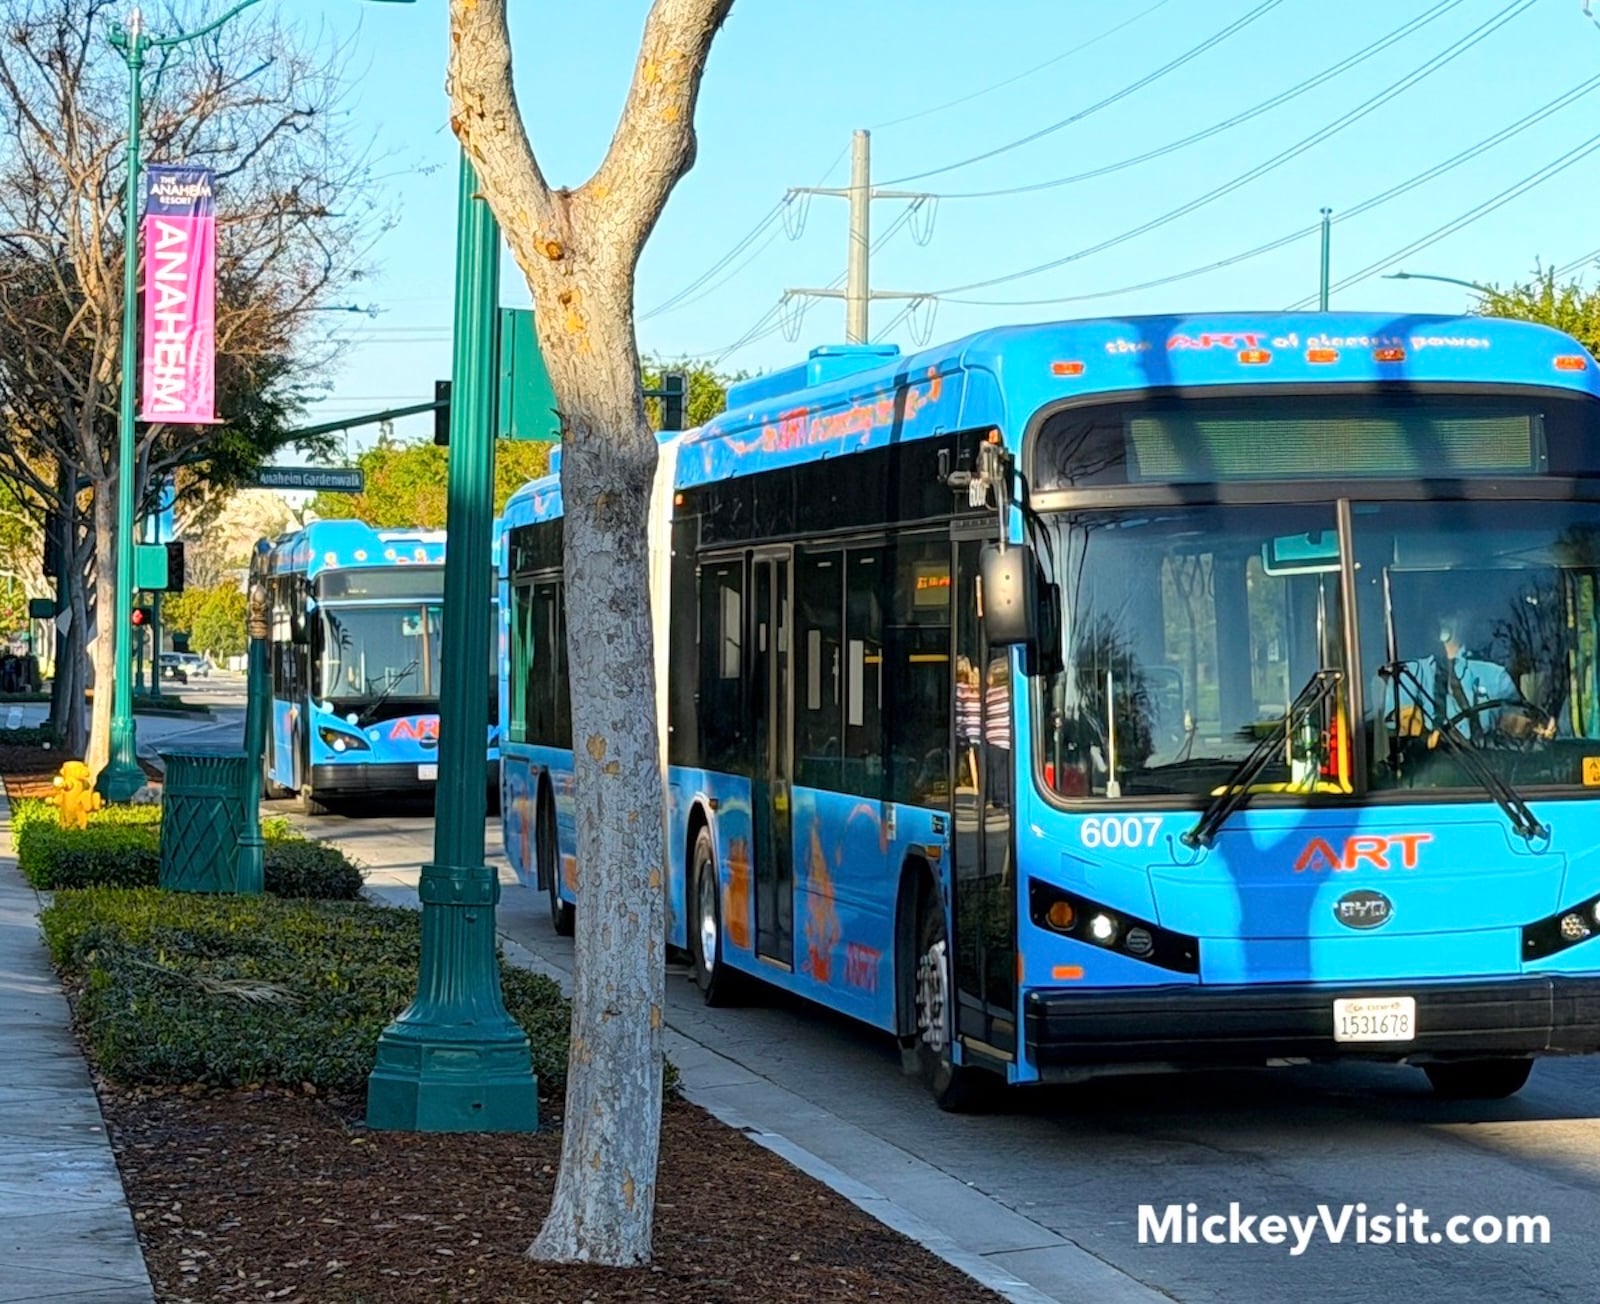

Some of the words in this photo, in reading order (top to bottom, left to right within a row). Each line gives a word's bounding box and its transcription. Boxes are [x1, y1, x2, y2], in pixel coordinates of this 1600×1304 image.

[160, 176, 176, 184] THE
[150, 183, 212, 197] ANAHEIM
[160, 196, 191, 205] RESORT
[154, 220, 187, 411] ANAHEIM
[1166, 333, 1265, 349] ART
[260, 472, 301, 486] Anaheim
[303, 473, 359, 487] Gardenwalk
[390, 718, 440, 740] AR
[1080, 816, 1164, 849] 6007
[1294, 833, 1434, 871] ART
[1340, 900, 1388, 917] BYD
[1341, 1014, 1409, 1036] 1531678
